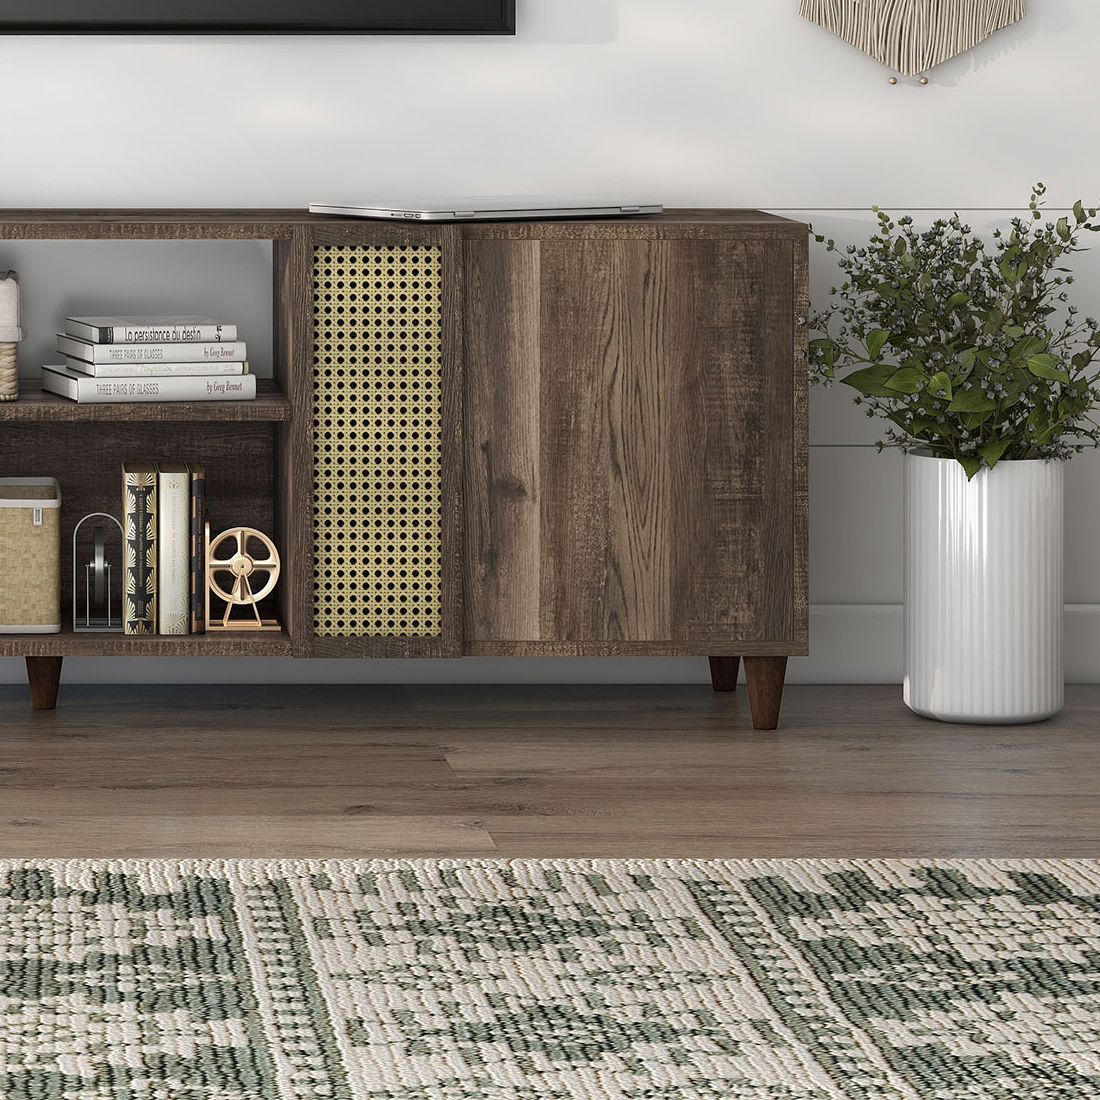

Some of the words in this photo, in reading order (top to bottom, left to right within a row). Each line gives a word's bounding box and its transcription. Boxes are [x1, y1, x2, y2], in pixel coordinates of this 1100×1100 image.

[109, 349, 123, 360] THREE
[124, 349, 136, 360] PAIRS
[137, 349, 143, 359] OF
[144, 349, 163, 359] GLASSES
[203, 347, 209, 359] by
[96, 384, 112, 396] THREE
[113, 384, 127, 396] PAIRS
[128, 383, 136, 395] OF
[137, 383, 159, 395] GLASSES
[206, 381, 212, 394] by
[213, 382, 225, 394] Greg
